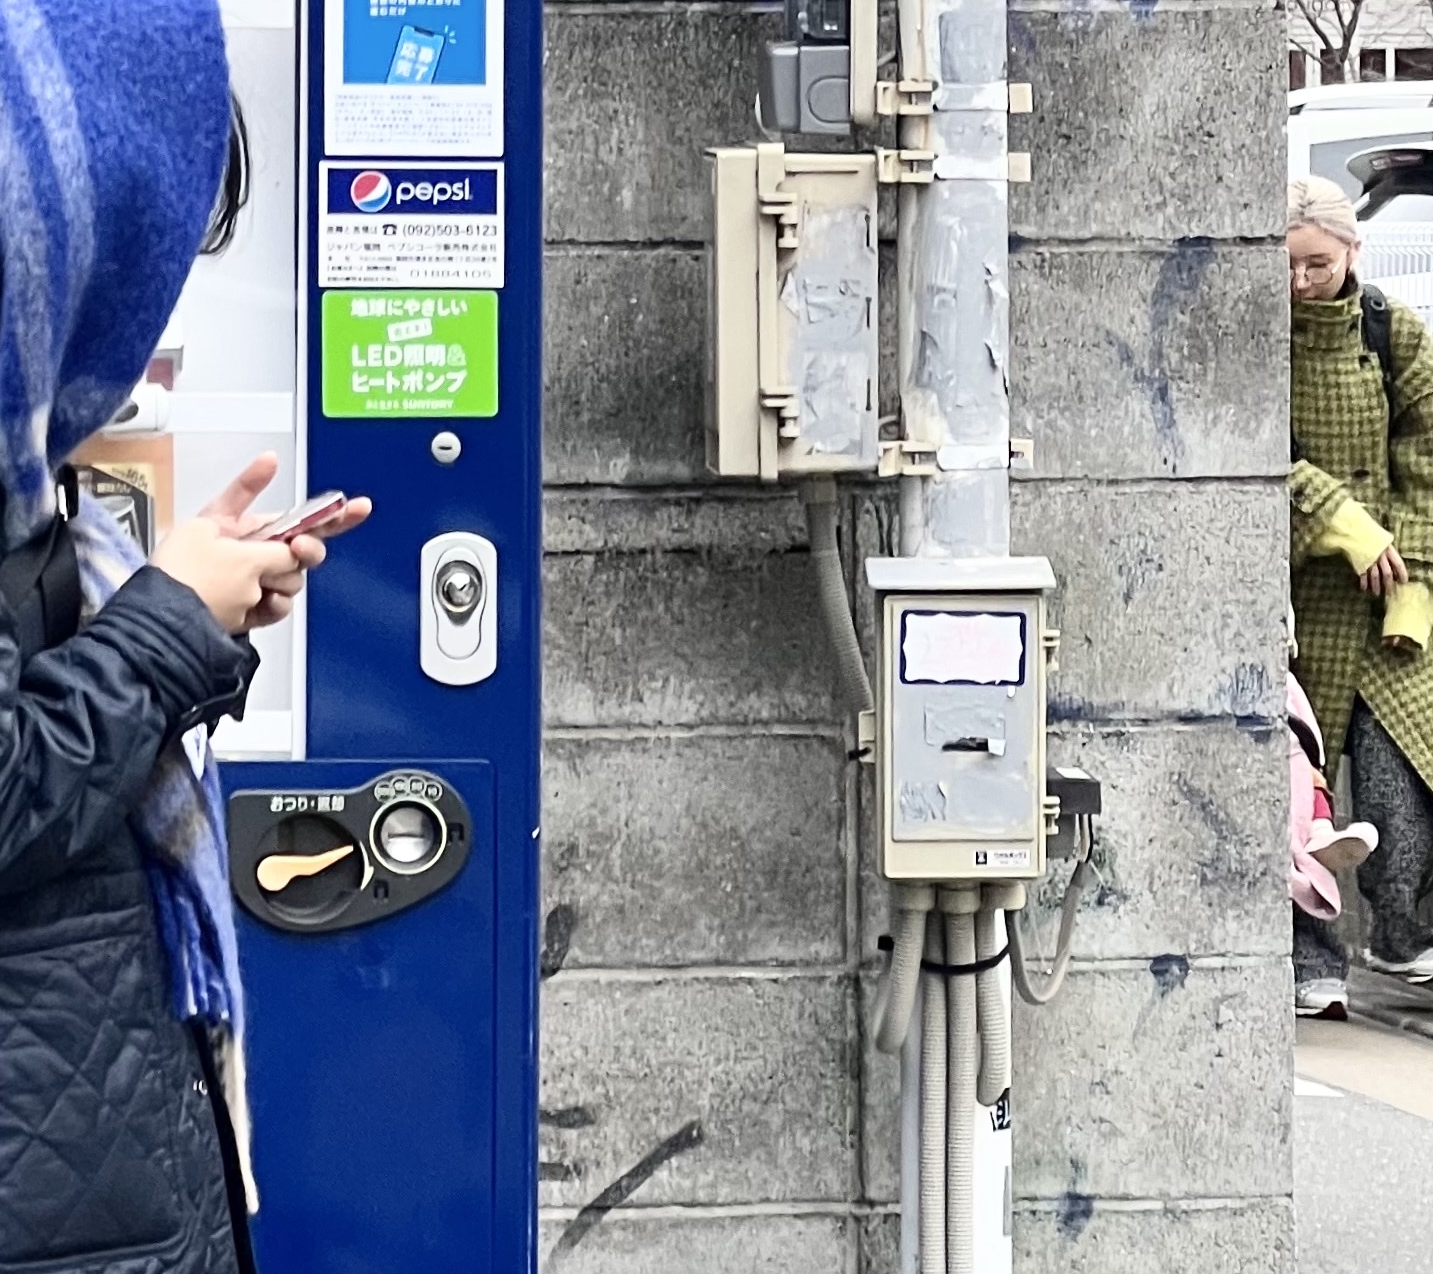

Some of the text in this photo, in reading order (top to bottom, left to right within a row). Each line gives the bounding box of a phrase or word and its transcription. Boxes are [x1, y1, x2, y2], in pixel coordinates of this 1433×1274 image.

[395, 177, 470, 205] pepsi
[350, 369, 468, 394] ヒートポンプ
